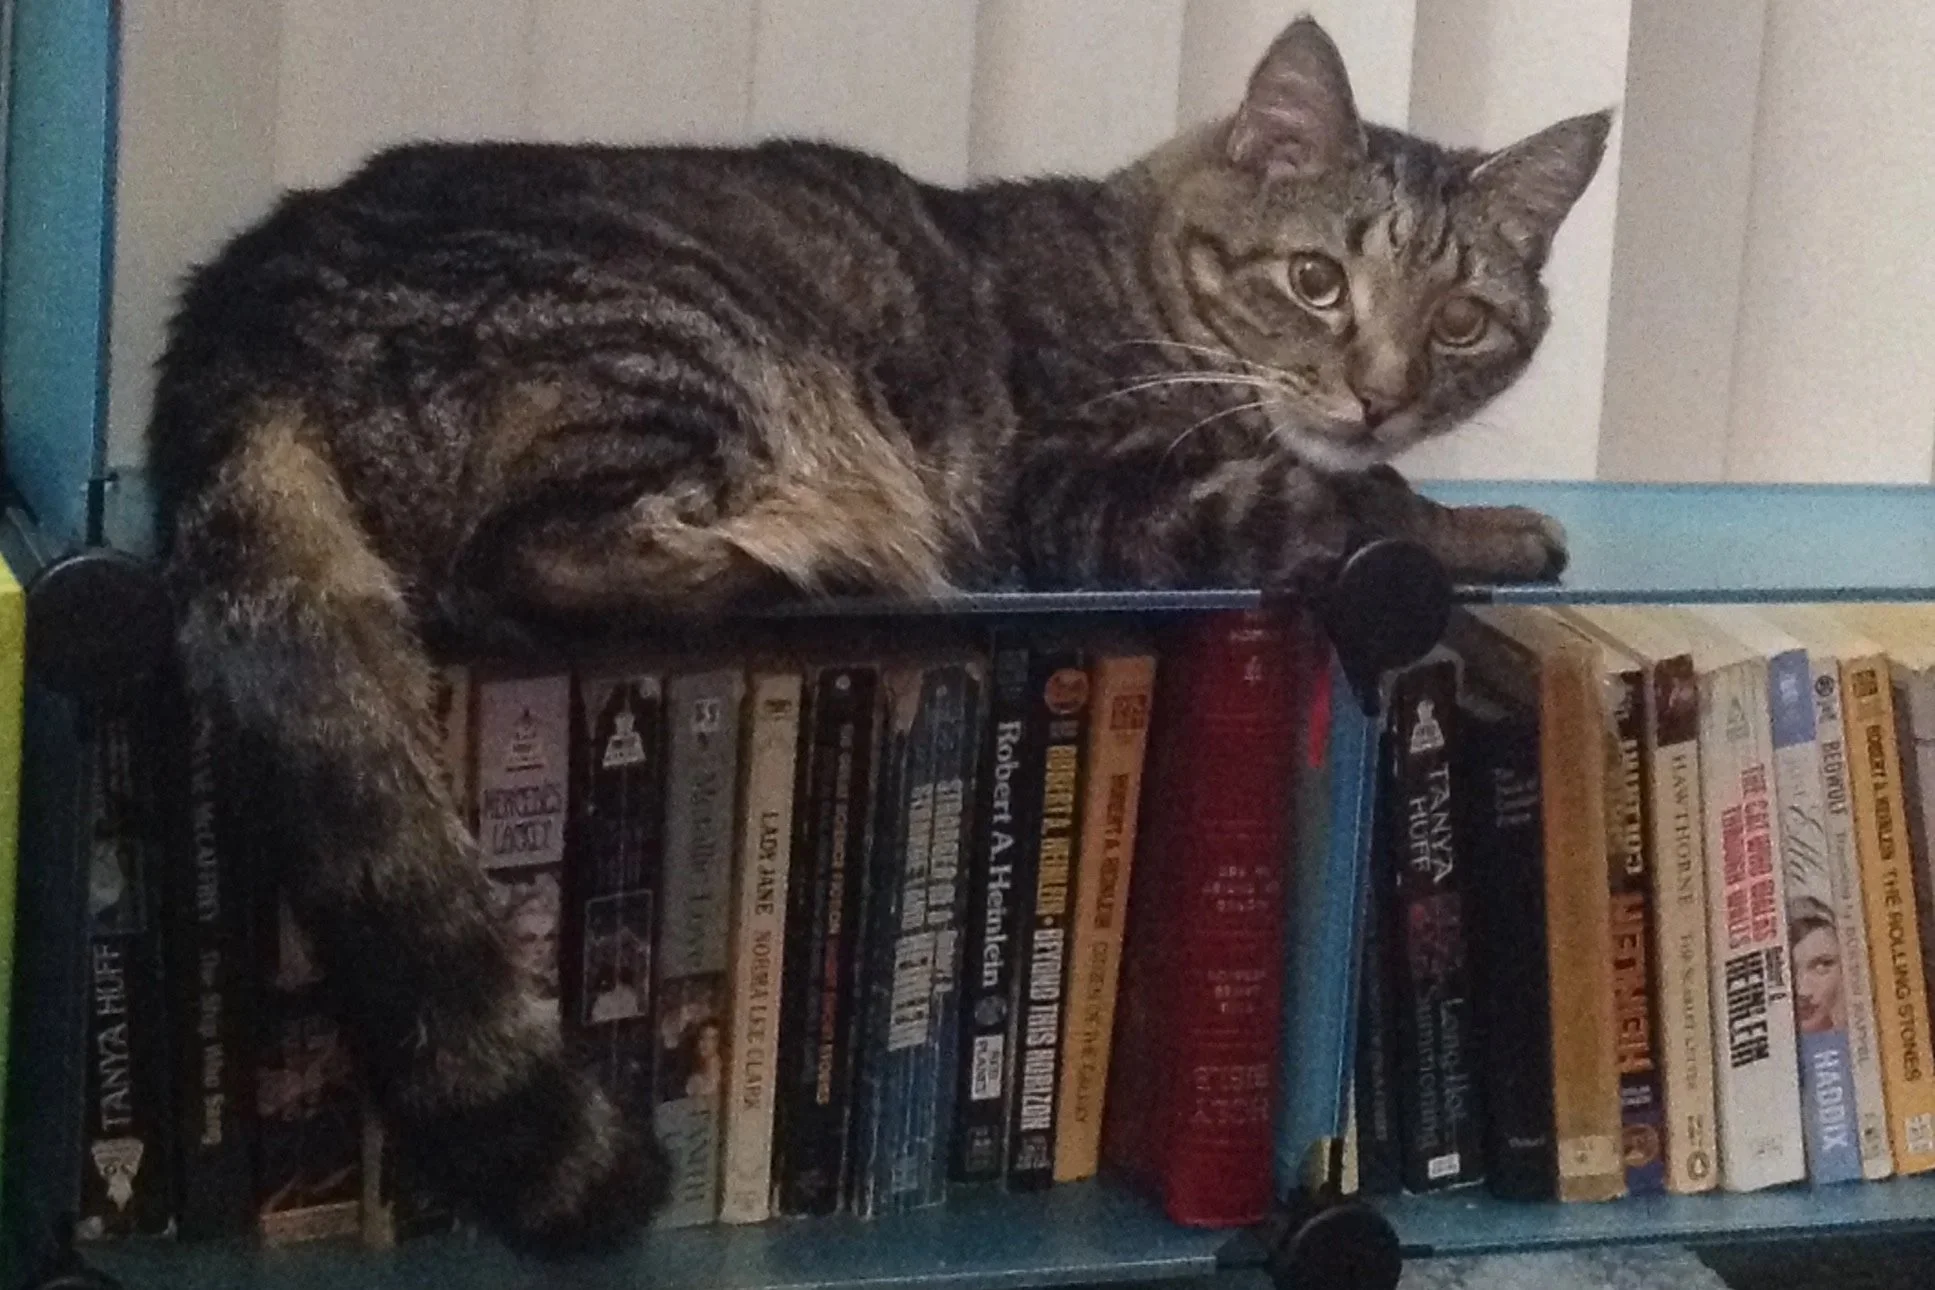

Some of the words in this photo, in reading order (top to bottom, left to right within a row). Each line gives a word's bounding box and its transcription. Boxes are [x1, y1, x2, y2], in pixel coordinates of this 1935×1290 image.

[992, 721, 1022, 824] Robert
[1044, 745, 1077, 814] ROBERT
[1742, 763, 1769, 798] THE
[1821, 740, 1847, 816] BEOWULF
[1866, 724, 1887, 778] ROBERT
[760, 811, 780, 863] LADY
[831, 803, 849, 869] SCIENCE
[930, 779, 964, 880] STRANGER
[1104, 773, 1130, 834] ROBERT
[1408, 796, 1432, 872] HUFF
[1427, 762, 1454, 885] TANYA
[1671, 754, 1696, 907] HAWTHORNE
[1744, 798, 1771, 833] CAT
[1874, 797, 1895, 861] HEINLEIN
[1035, 837, 1071, 916] HEINLEIN
[1722, 804, 1747, 887] THROUGH
[1747, 834, 1774, 878] WHO
[1786, 804, 1824, 886] Ella
[753, 867, 775, 915] JANE
[827, 872, 844, 935] FICTION
[1095, 856, 1121, 930] HEINLEIN
[1727, 889, 1752, 950] WALLS
[1751, 880, 1778, 943] WALKS
[1885, 868, 1903, 906] THE
[981, 863, 1012, 988] Heinlein
[1889, 911, 1912, 1001] ROLLING
[94, 945, 128, 1016] HUFF
[749, 930, 773, 999] NORMA
[1030, 928, 1064, 1000] BEYOND
[1611, 892, 1651, 1074] HEINLEIN
[746, 1005, 766, 1044] LEE
[1027, 1003, 1058, 1046] THIS
[1438, 997, 1465, 1069] Long
[1725, 950, 1771, 1069] HEINLEIN
[1898, 1004, 1921, 1083] STONES
[98, 1023, 133, 1132] TANYA
[202, 1044, 224, 1087] Who
[743, 1047, 764, 1110] CLARK
[816, 1044, 834, 1106] STORIES
[1020, 1049, 1055, 1130] HORIZON
[1415, 984, 1439, 1151] Summoning
[1813, 1048, 1849, 1152] HADDIX
[201, 1093, 225, 1146] Sang
